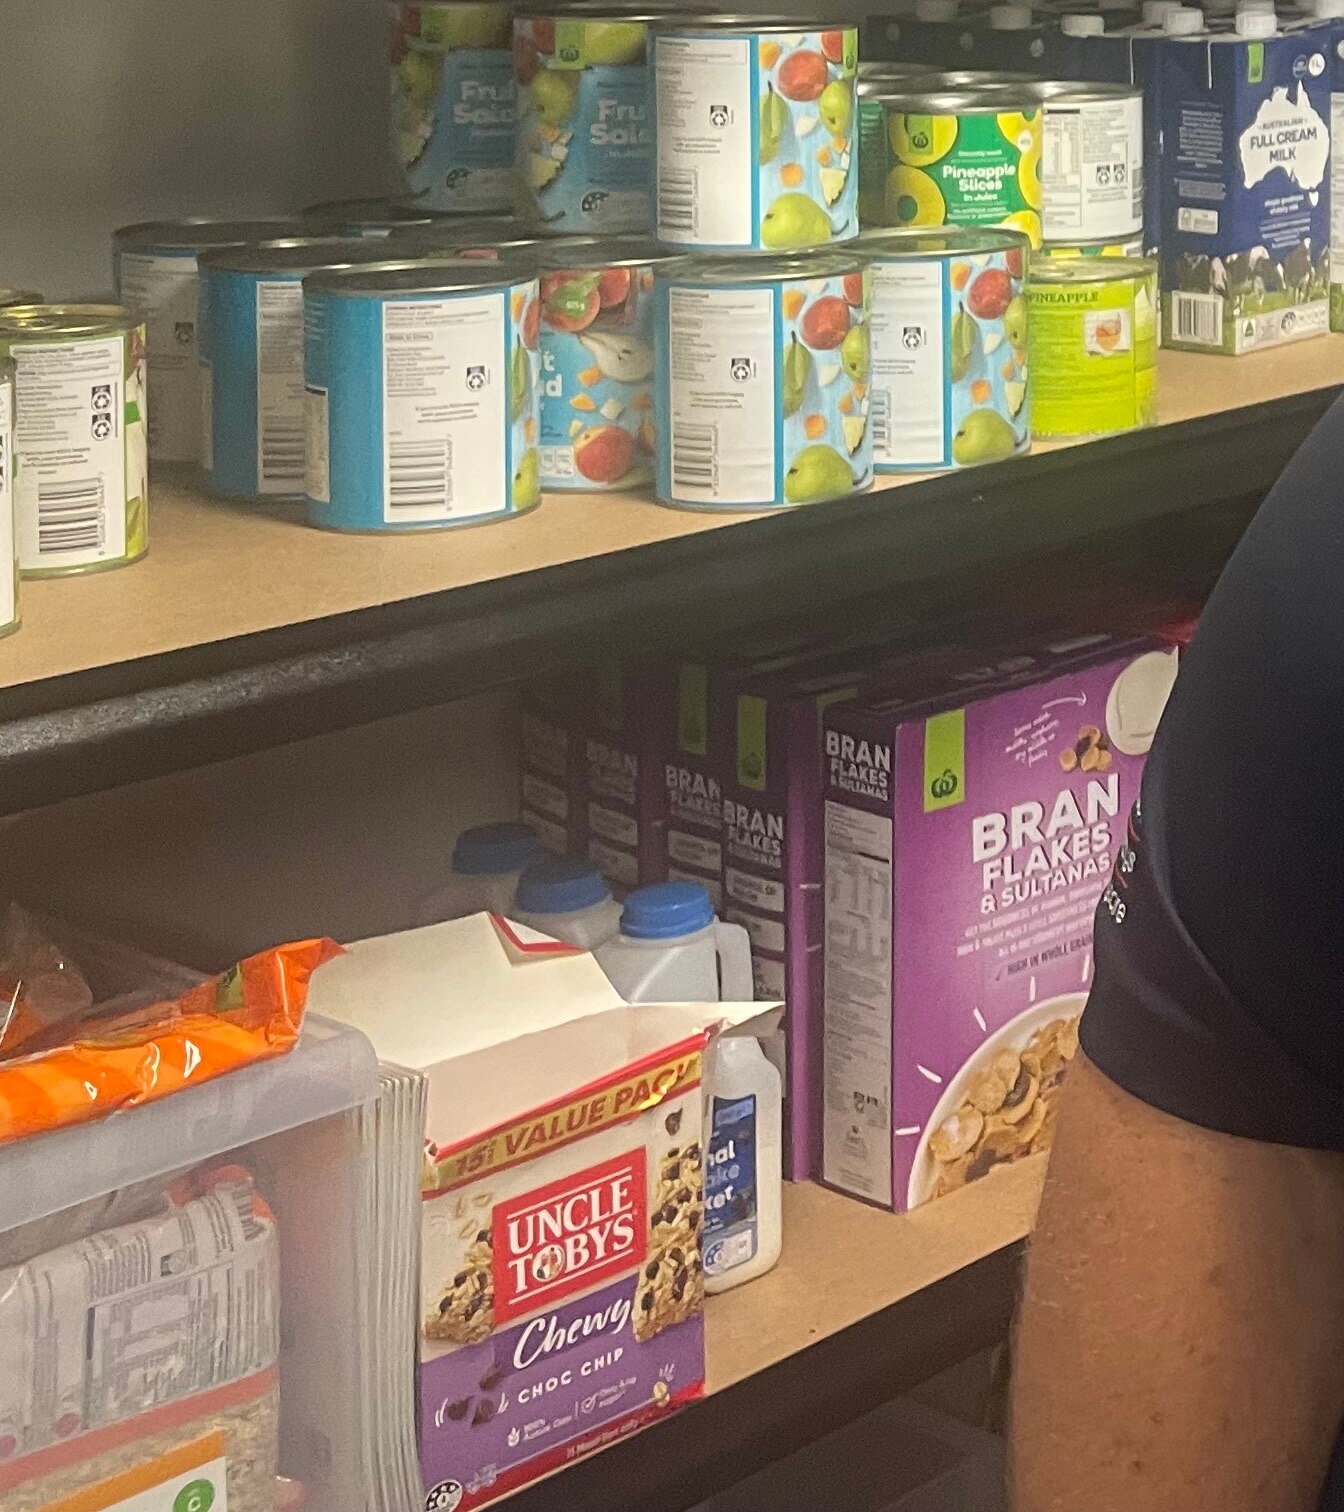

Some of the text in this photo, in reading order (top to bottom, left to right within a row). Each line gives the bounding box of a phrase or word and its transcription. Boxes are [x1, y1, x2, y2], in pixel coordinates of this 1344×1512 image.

[598, 99, 648, 122] Fru
[1250, 125, 1318, 151] FULL CREAM
[1269, 147, 1297, 163] MILK
[942, 163, 1016, 180] Pineapple
[958, 178, 1003, 192] Slices
[826, 730, 891, 774] BRAN
[830, 757, 888, 789] FLAKES
[665, 763, 722, 801] BRAN
[724, 799, 784, 841] BRAN
[972, 772, 1120, 865] BRAN
[982, 822, 1112, 892] FLAKES
[980, 893, 998, 915] &
[1000, 851, 1111, 910] SULTANAS
[504, 1099, 606, 1156] VALUE
[508, 1173, 634, 1256] UNCLE
[508, 1212, 635, 1295] TOBYS
[513, 1298, 632, 1370] Chewy
[517, 1346, 625, 1405] CHOC CHIP
